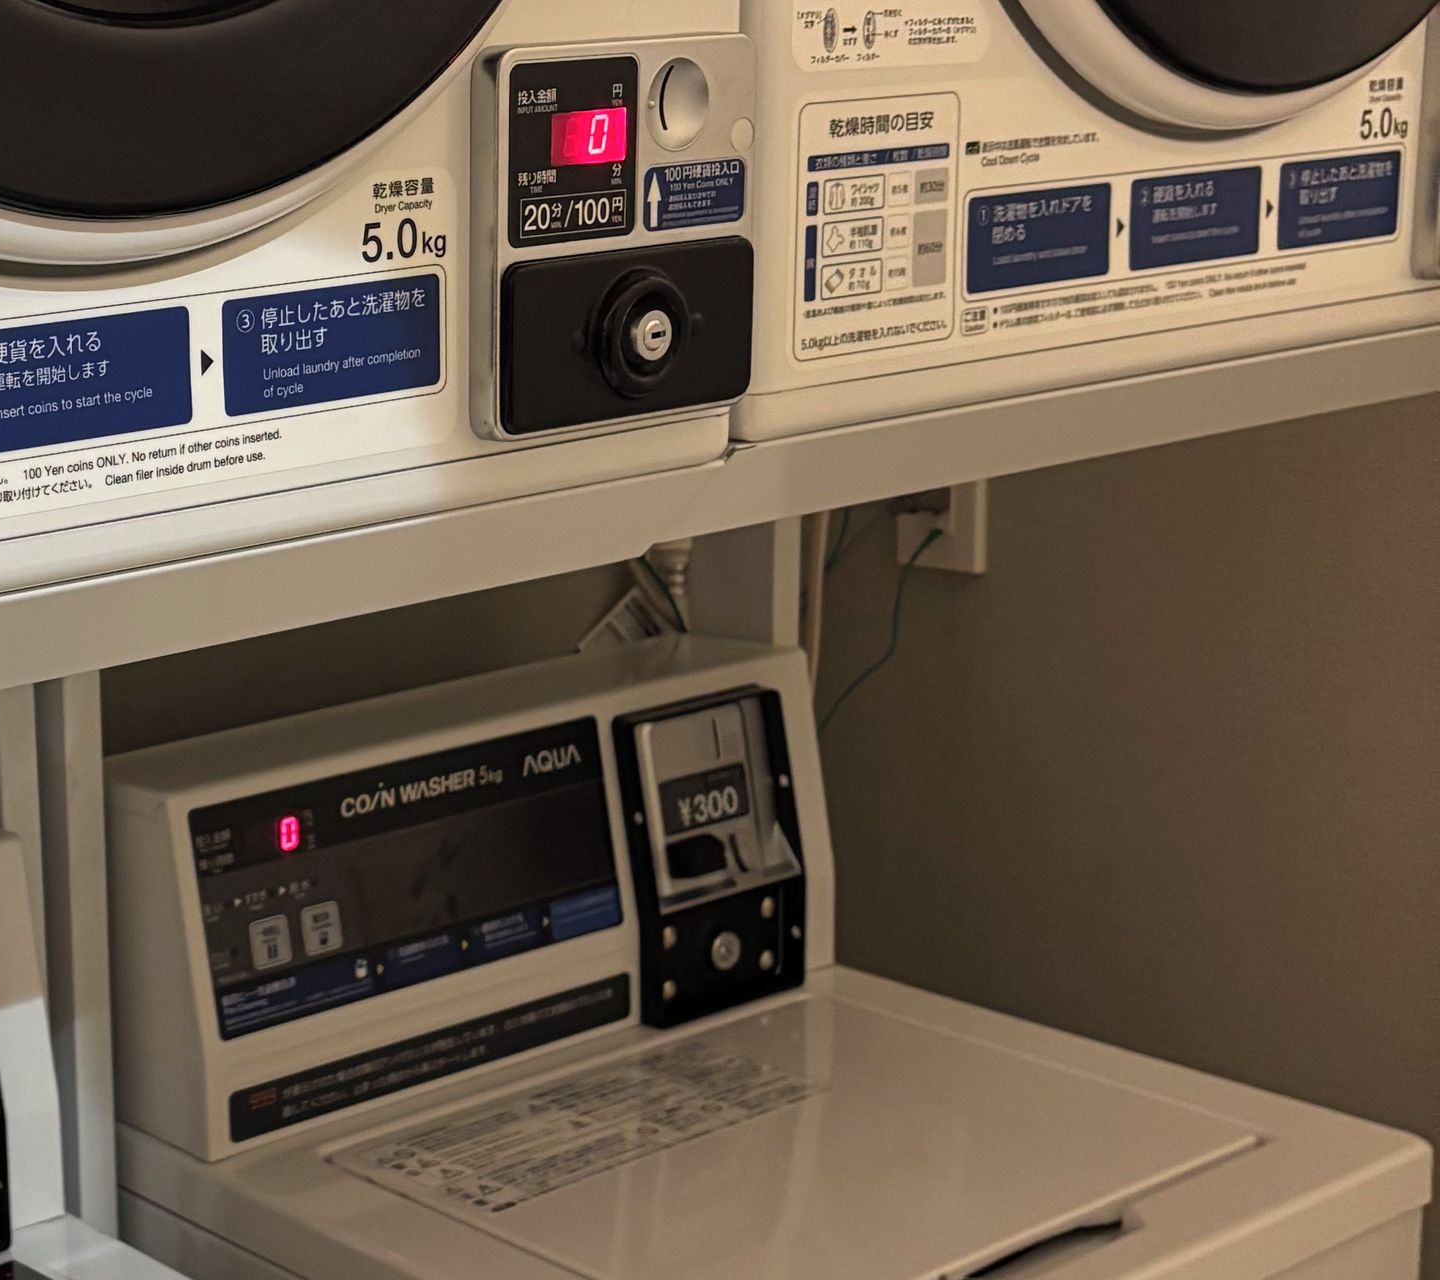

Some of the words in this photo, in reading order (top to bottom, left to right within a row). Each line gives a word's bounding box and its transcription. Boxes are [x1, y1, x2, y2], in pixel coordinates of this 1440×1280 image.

[518, 88, 557, 105] 投入金額
[612, 83, 623, 98] 円
[588, 113, 609, 155] 0
[829, 111, 934, 138] 乾燥時間の目安
[518, 168, 557, 186] 残り時間
[612, 162, 622, 177] 分
[372, 178, 435, 200] 乾燥容量
[375, 201, 397, 214] Dryer
[398, 198, 433, 213] Capacity
[261, 288, 425, 329] 停止したあと洗濯物を
[261, 326, 327, 354] 取り出す
[263, 364, 299, 381] Unload
[302, 359, 339, 378] laundry
[342, 354, 365, 368] after
[367, 346, 421, 368] completion
[29, 401, 58, 417] coins
[61, 398, 72, 411] to
[75, 395, 102, 410] start
[104, 392, 121, 405] the
[124, 386, 153, 403] cycle
[264, 385, 275, 398] of
[277, 381, 304, 397] cycle
[23, 468, 42, 480] 100
[45, 464, 64, 477] Yen
[67, 461, 94, 473] coins
[97, 455, 129, 469] ONLY.
[132, 452, 146, 463] No
[149, 447, 176, 460] return
[179, 444, 187, 455] if
[188, 440, 212, 454] other
[215, 436, 240, 449] coins
[242, 429, 282, 444] inserted.
[105, 473, 133, 486] Clean
[136, 469, 154, 481] filer
[156, 465, 184, 477] inside
[187, 461, 211, 473] drum
[214, 454, 244, 468] before
[247, 451, 266, 462] use.
[340, 781, 396, 818] COIN
[399, 768, 474, 805] WASHER
[522, 744, 581, 776] AQUA
[678, 785, 738, 827] ¥300
[278, 814, 300, 852] 0
